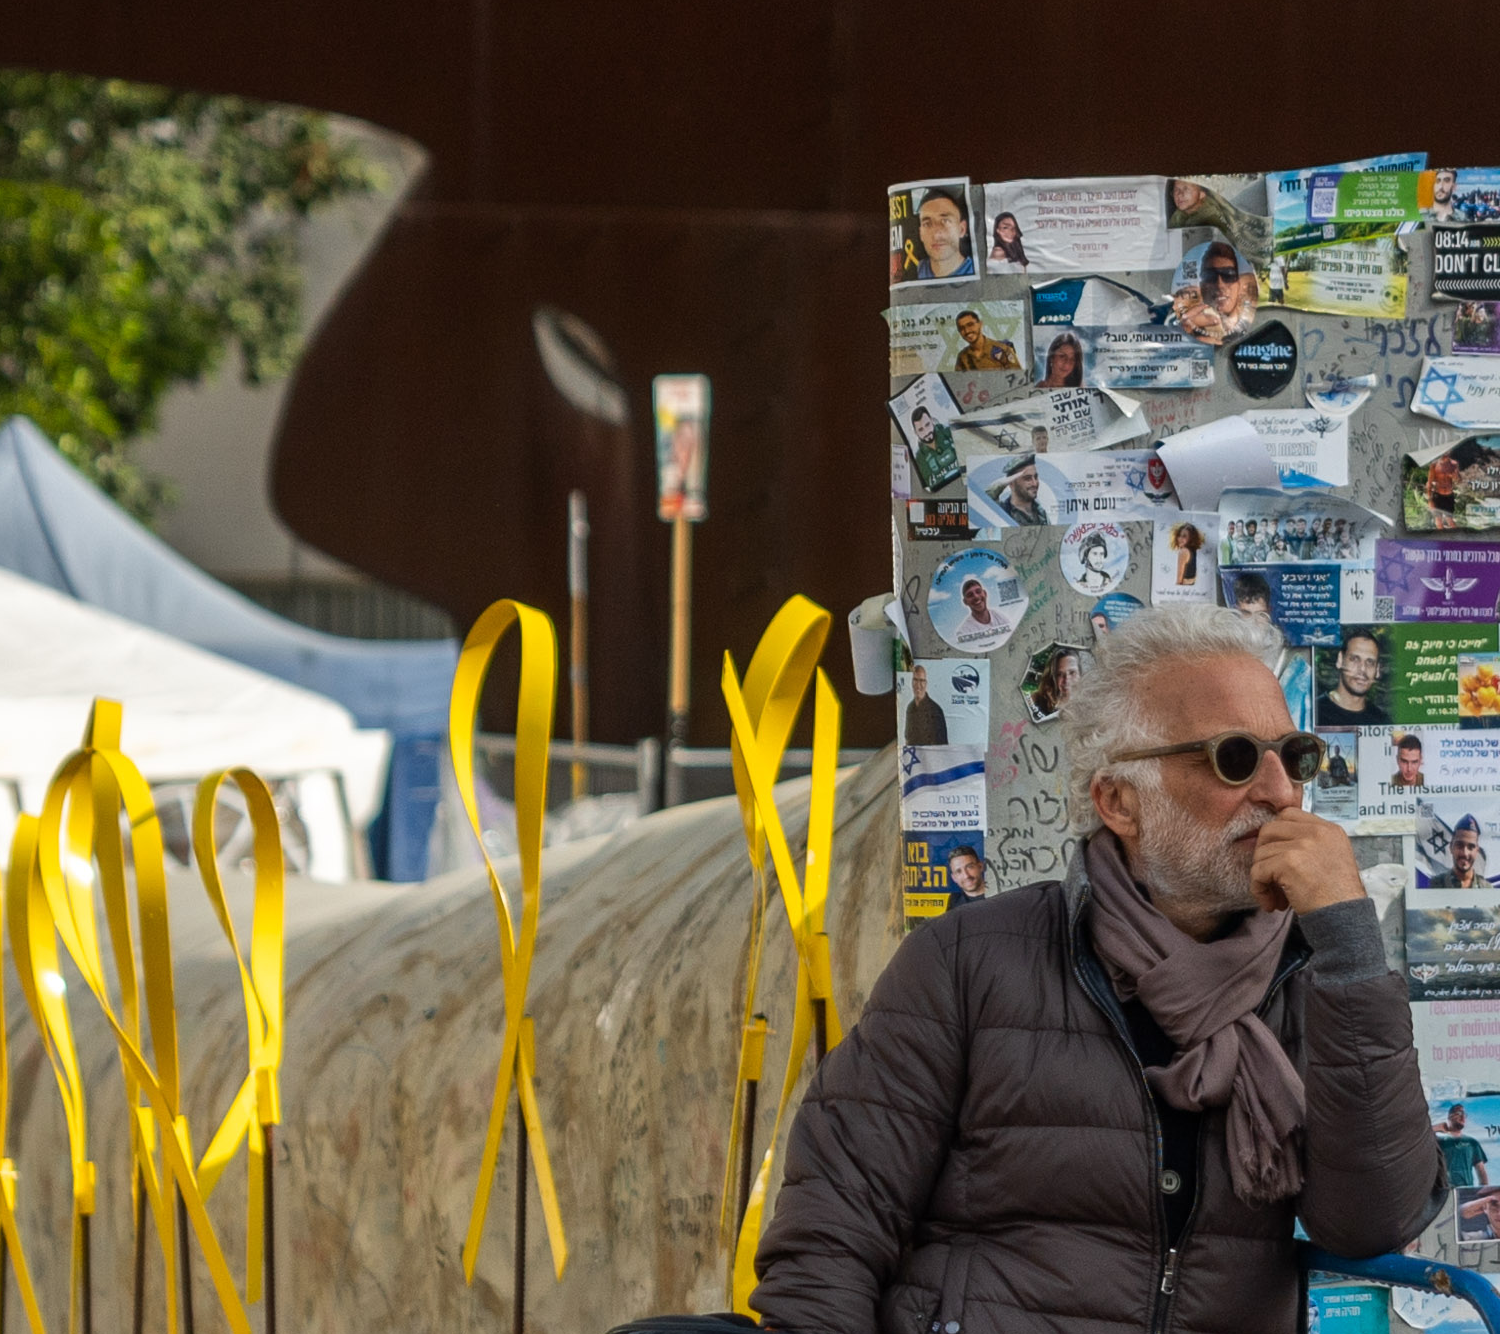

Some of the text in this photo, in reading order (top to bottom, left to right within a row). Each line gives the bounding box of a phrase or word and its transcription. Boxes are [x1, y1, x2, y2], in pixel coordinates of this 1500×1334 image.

[1435, 231, 1469, 249] 08:14
[1435, 253, 1479, 274] DON'T
[1053, 397, 1089, 412] אותי
[1066, 497, 1116, 514] נועם איתן
[1440, 739, 1454, 748] ילד
[1456, 738, 1483, 748] העולם
[1485, 738, 1498, 747] של
[908, 842, 929, 863] בוא
[1447, 1024, 1459, 1038] or
[1432, 1045, 1444, 1061] to
